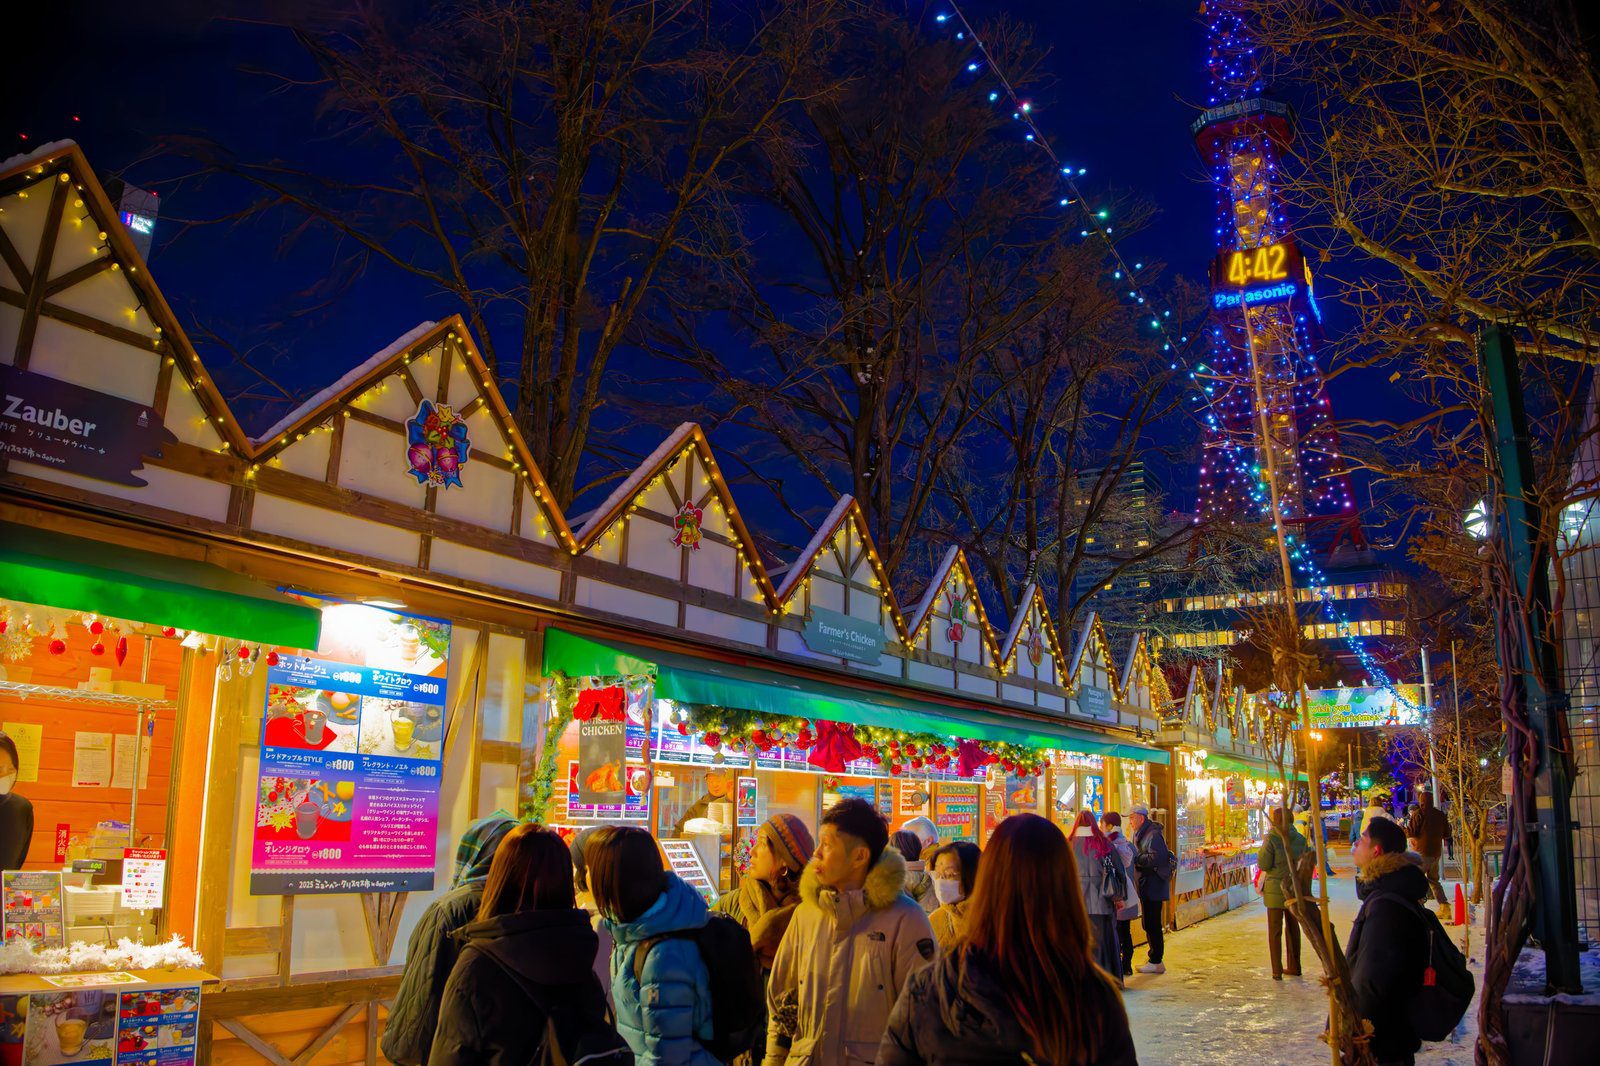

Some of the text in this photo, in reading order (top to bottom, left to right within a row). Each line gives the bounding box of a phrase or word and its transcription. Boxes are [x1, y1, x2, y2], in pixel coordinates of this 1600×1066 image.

[1229, 244, 1287, 285] 4:42
[3, 394, 97, 438] Zauber
[819, 622, 850, 640] Farmer's
[850, 631, 876, 647] Chicken
[279, 661, 327, 675] ホットルージュ
[373, 674, 412, 686] ホワイトグロウ
[1333, 705, 1351, 715] you
[581, 724, 623, 737] CHICKEN
[303, 756, 323, 764] STYLE
[56, 829, 67, 856] 消火器
[264, 845, 310, 854] オレンジグロウ
